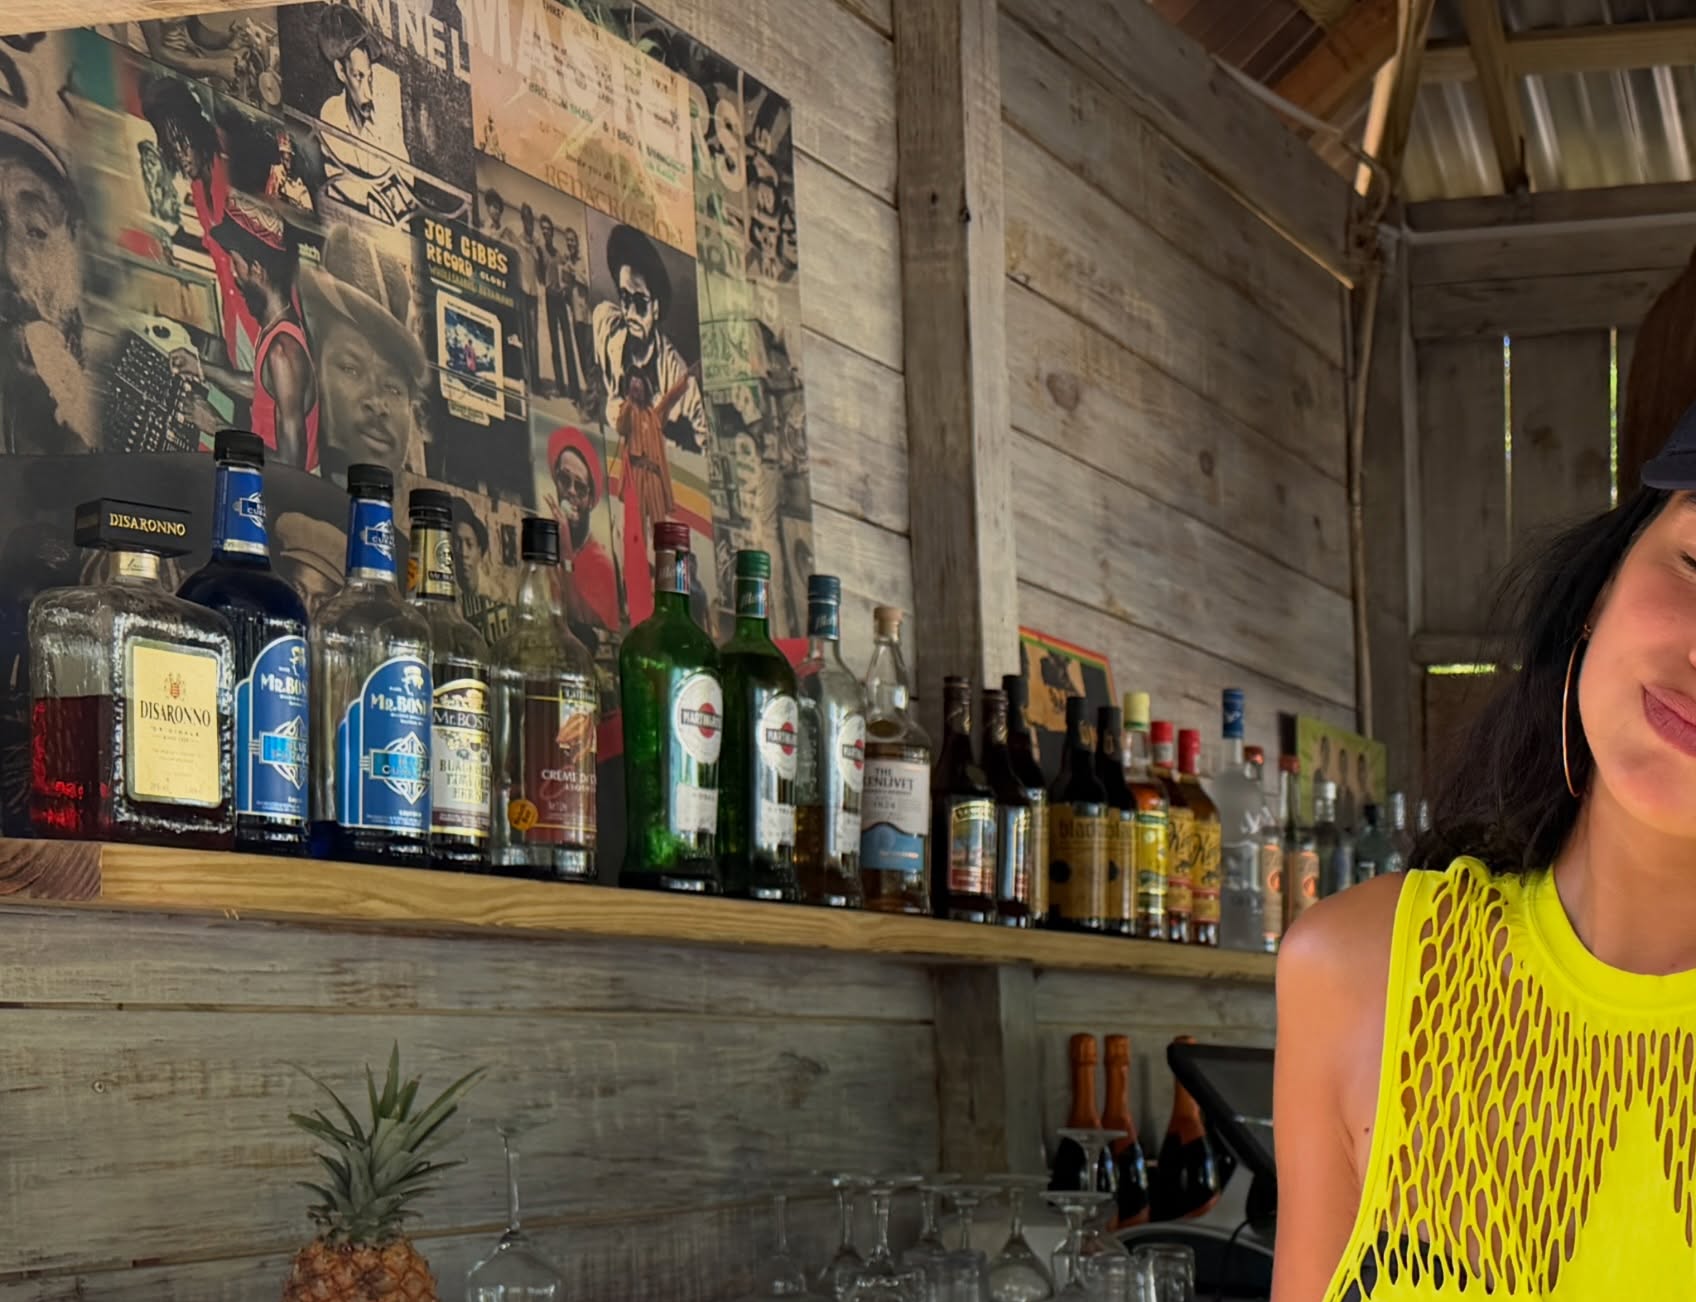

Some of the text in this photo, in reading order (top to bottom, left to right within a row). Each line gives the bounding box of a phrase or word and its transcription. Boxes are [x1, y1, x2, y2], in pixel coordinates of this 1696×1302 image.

[424, 217, 453, 250] JOE
[426, 241, 474, 278] RECORD
[109, 512, 186, 537] DISARONNO
[140, 699, 212, 728] DISARONNO
